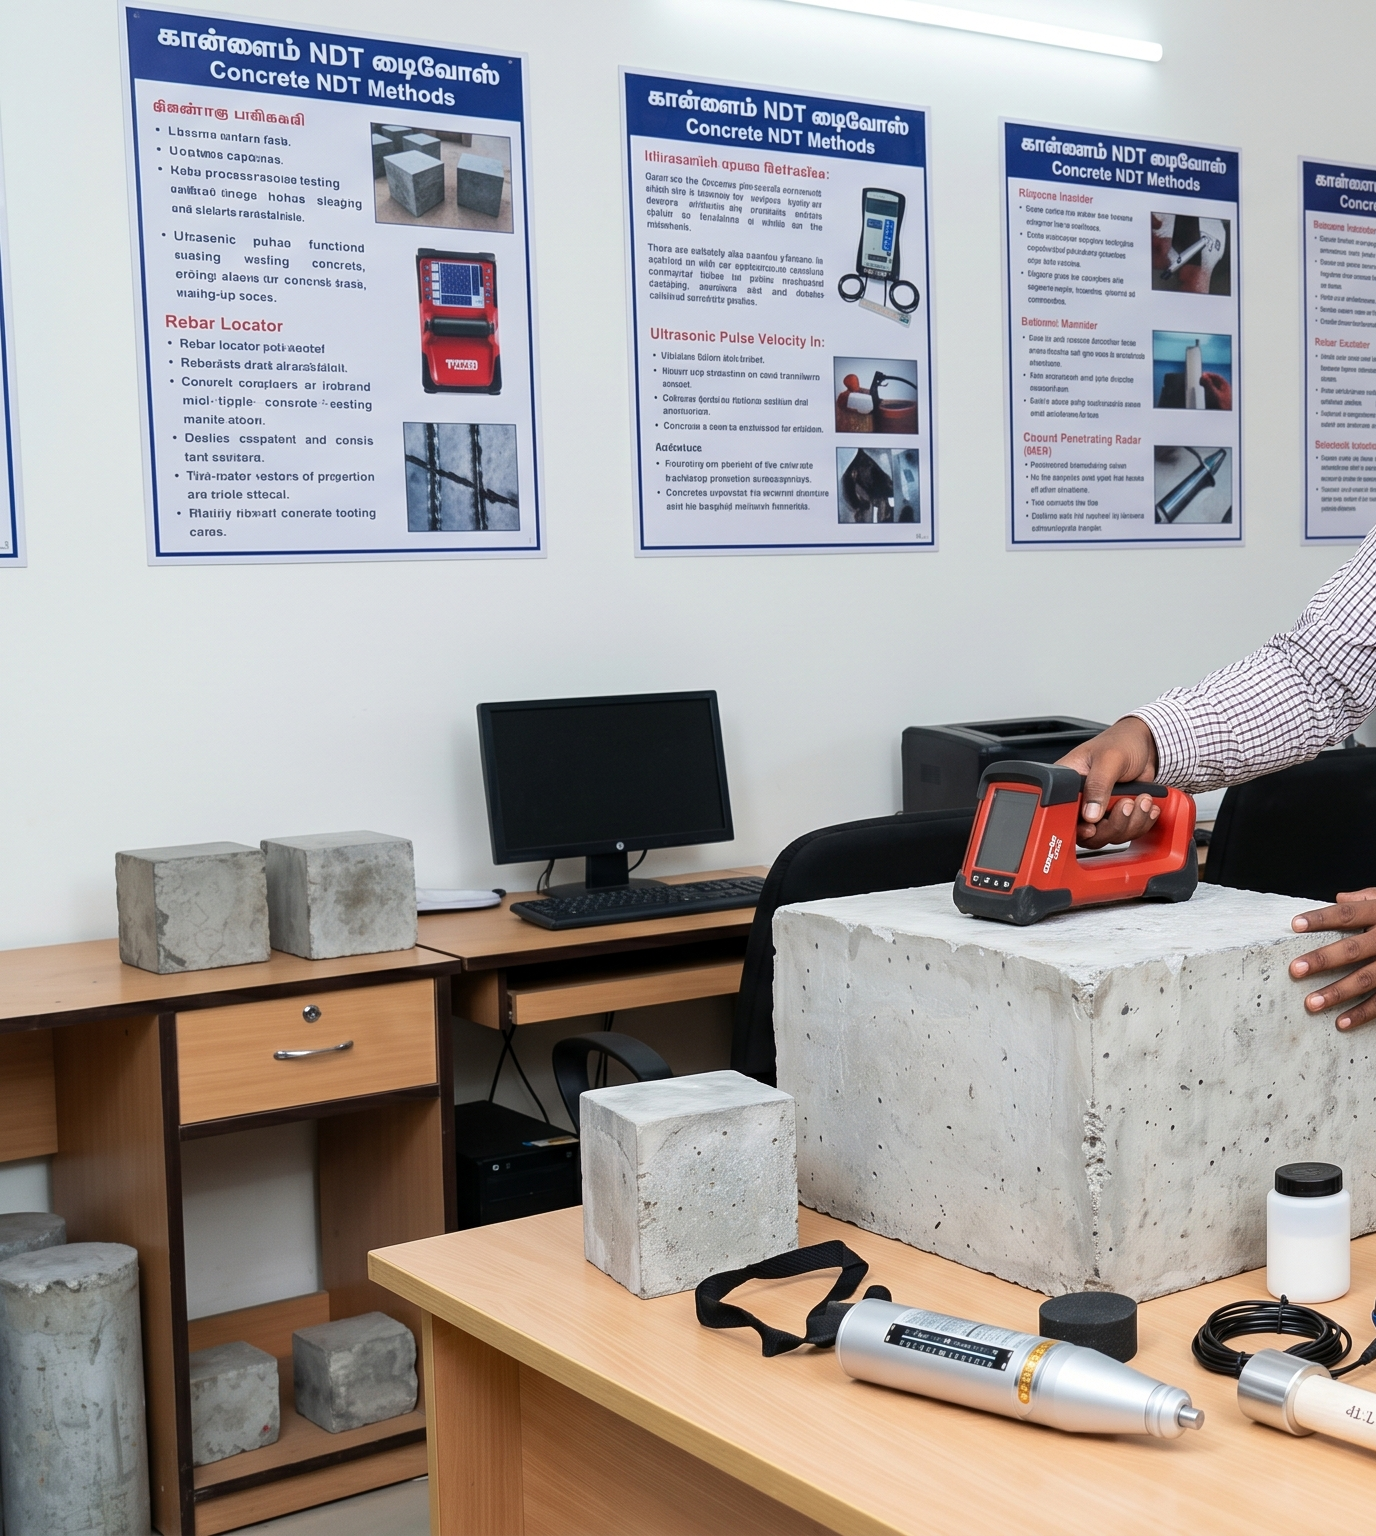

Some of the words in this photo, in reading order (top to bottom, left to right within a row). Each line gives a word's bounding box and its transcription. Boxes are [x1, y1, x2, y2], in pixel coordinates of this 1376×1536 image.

[309, 41, 364, 68] NDT
[209, 60, 310, 89] Concrete
[316, 72, 361, 95] NDT
[367, 78, 455, 106] Methods
[763, 99, 806, 123] NDT
[686, 117, 763, 142] Concrete
[768, 127, 803, 146] NDT
[807, 131, 875, 154] Methods
[1111, 144, 1147, 164] NDT
[685, 176, 699, 185] the
[1051, 160, 1112, 181] Concrete
[1115, 167, 1144, 184] NDT
[1147, 171, 1200, 191] Methods
[299, 175, 340, 191] testing
[810, 222, 823, 231] the
[308, 239, 365, 253] functiond
[311, 260, 365, 273] concrets,
[771, 288, 787, 296] and
[165, 314, 215, 329] Rebar
[220, 316, 283, 332] Locator
[179, 338, 216, 349] Rebar
[219, 339, 260, 351] locator
[650, 327, 716, 342] Ultrasonic
[719, 330, 754, 344] Pulse
[757, 332, 806, 349] Velocity
[810, 335, 825, 347] In:
[304, 382, 317, 390] ar
[184, 432, 230, 443] Deslies
[305, 435, 326, 445] and
[335, 435, 374, 446] consis
[1060, 432, 1113, 447] Penetrating
[1115, 434, 1141, 445] Radar
[184, 452, 209, 462] tant
[754, 460, 763, 469] of
[302, 471, 314, 481] of
[210, 489, 243, 499] triole
[665, 488, 708, 497] Concretes
[335, 507, 376, 520] tooting
